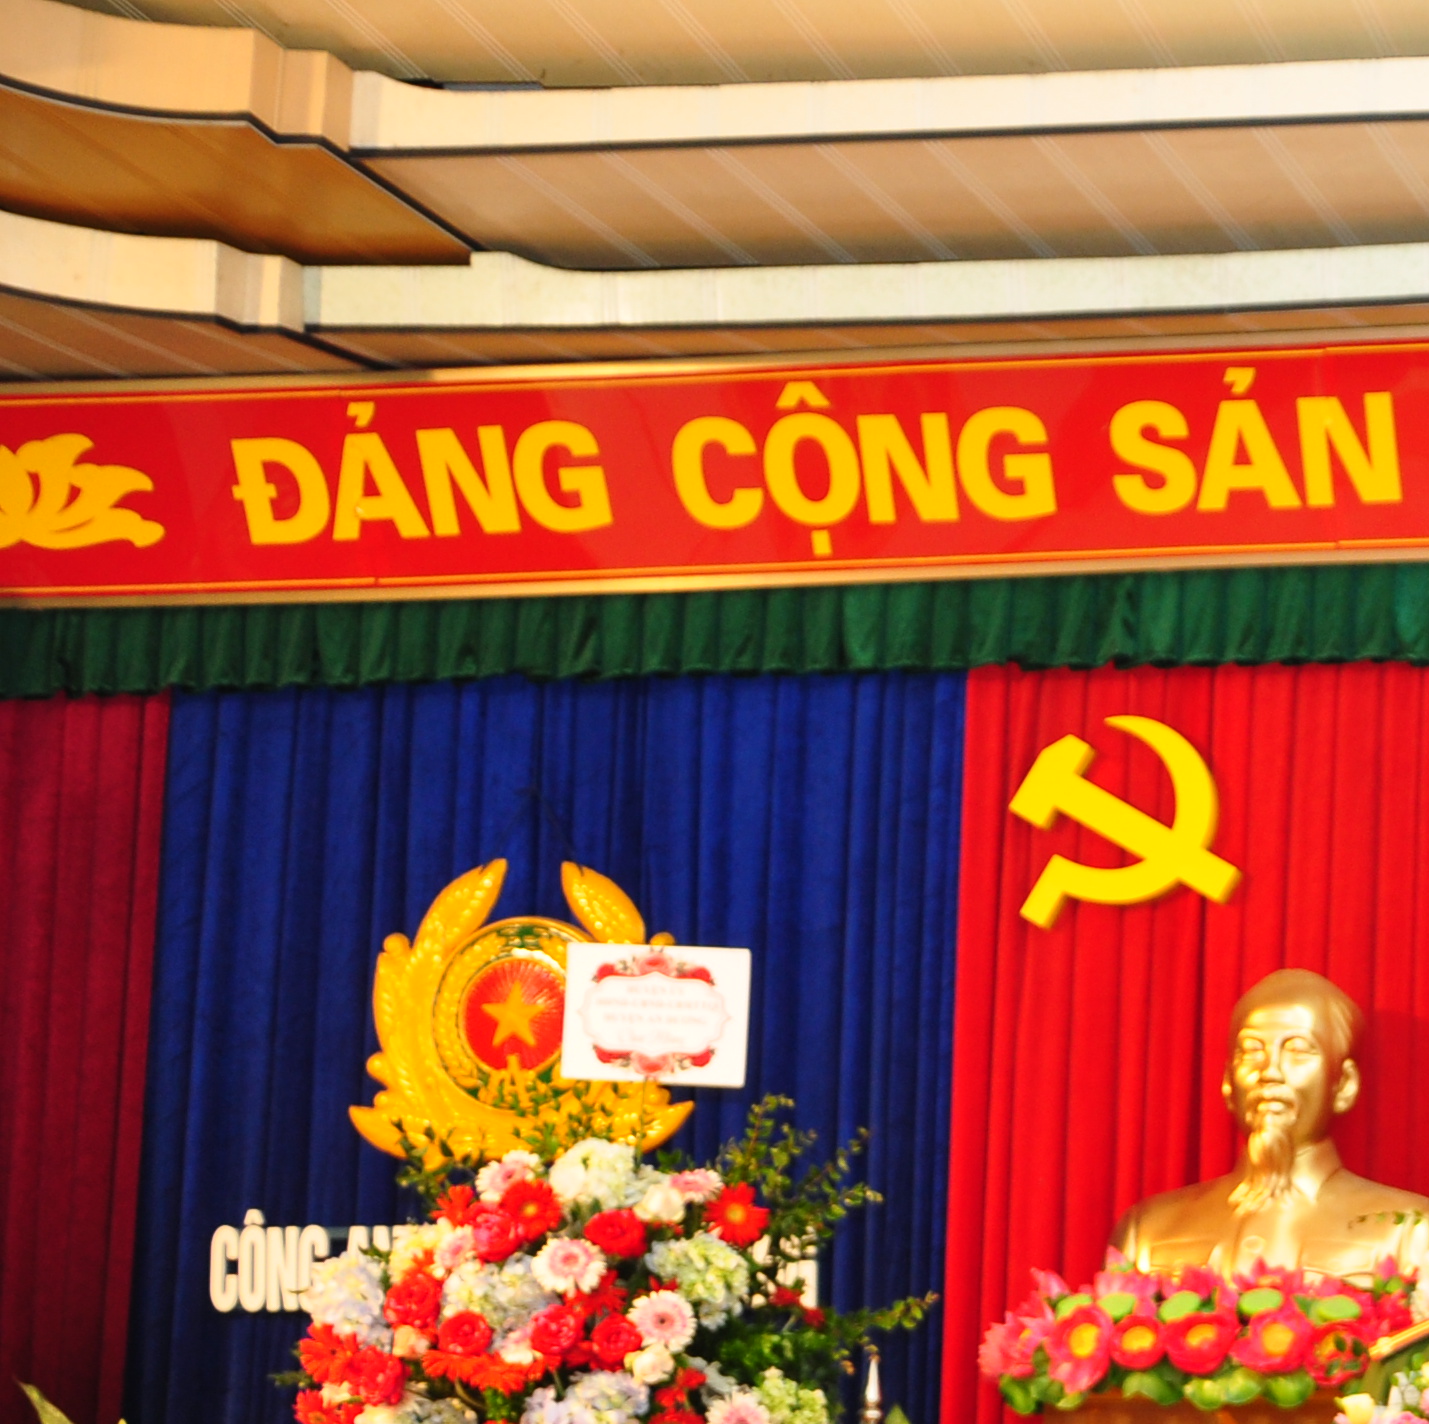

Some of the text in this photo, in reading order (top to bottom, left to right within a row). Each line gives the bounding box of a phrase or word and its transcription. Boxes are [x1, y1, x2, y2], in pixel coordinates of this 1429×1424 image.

[231, 402, 614, 545] ĐẢNG
[672, 381, 1057, 557] CỘNG
[1109, 367, 1403, 515] SẢN
[210, 1208, 330, 1313] CÔNG
